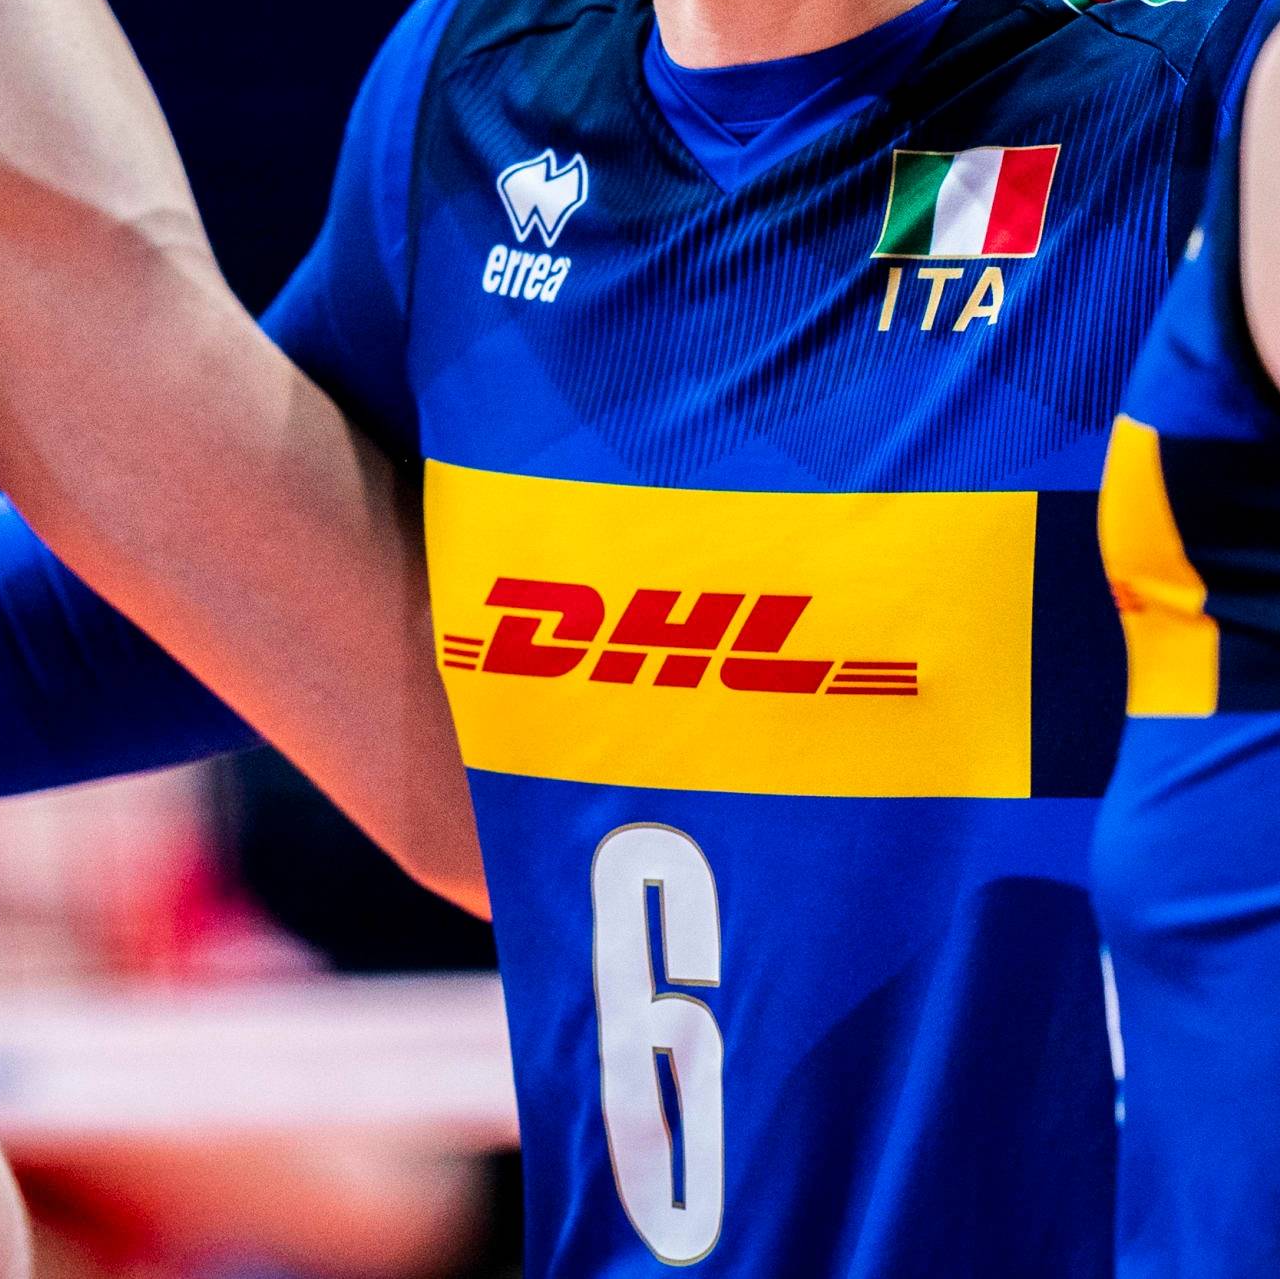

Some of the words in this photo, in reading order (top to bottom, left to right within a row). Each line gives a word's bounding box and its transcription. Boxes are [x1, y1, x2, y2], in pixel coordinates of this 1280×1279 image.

[877, 266, 1005, 332] ITA
[482, 577, 835, 695] DHL
[591, 822, 724, 1267] 6
